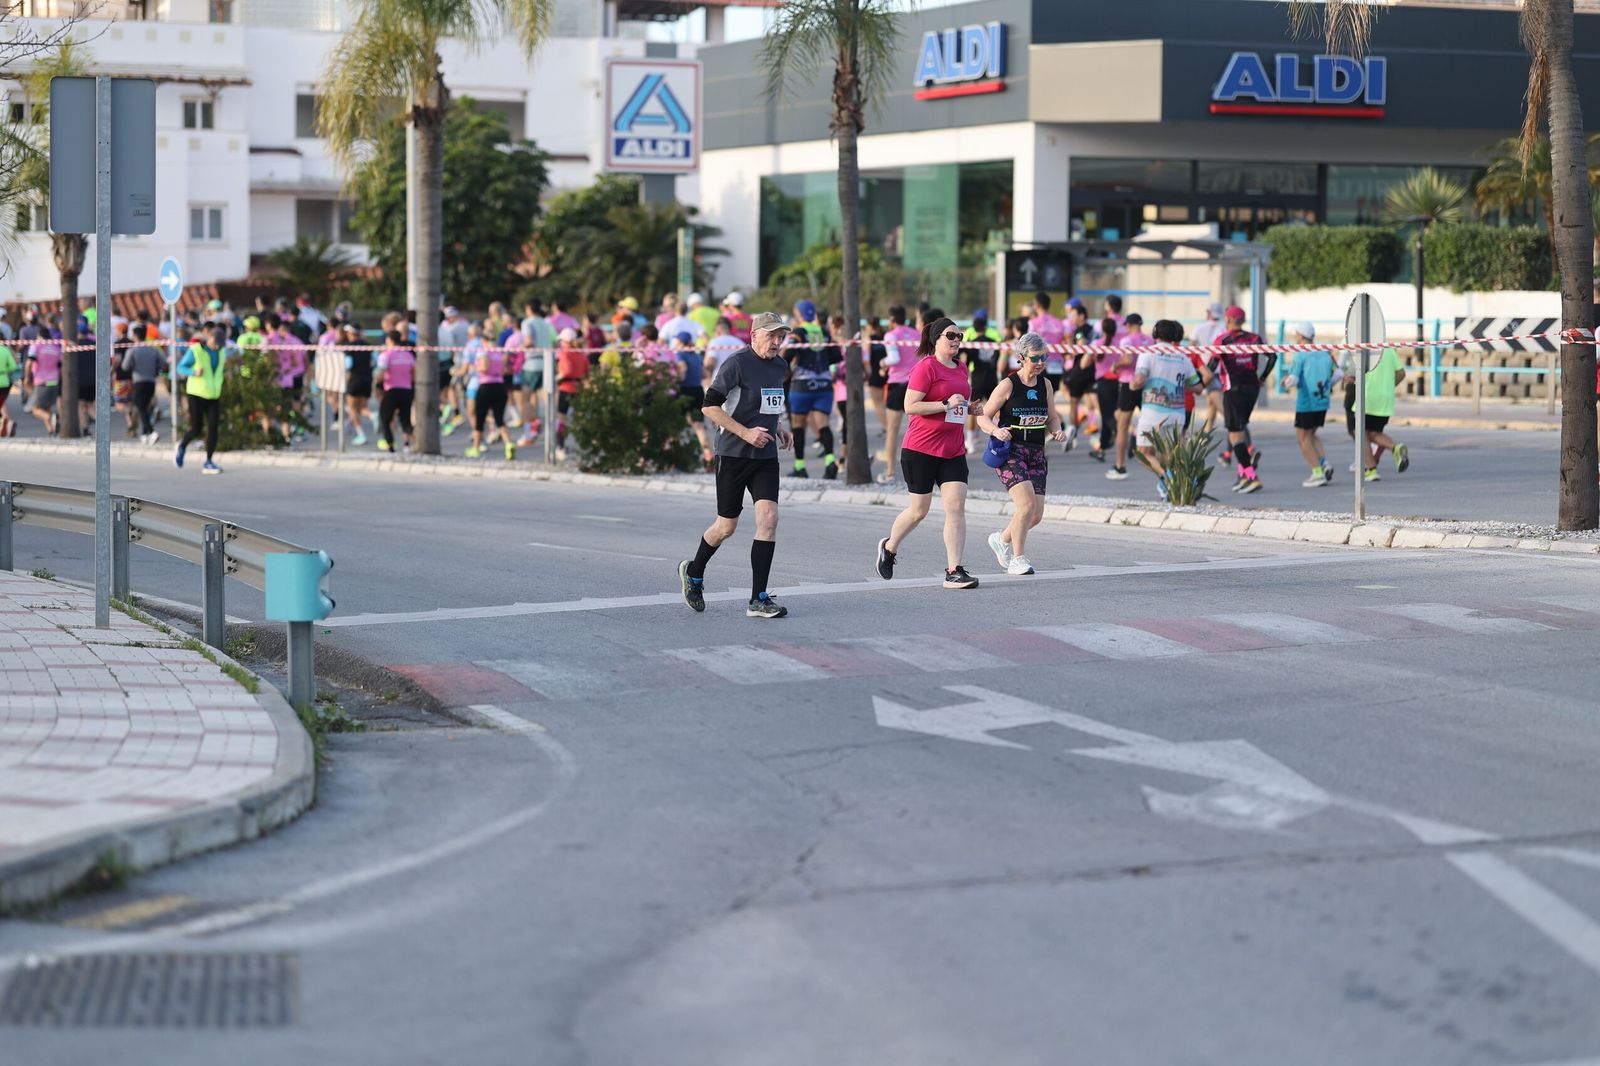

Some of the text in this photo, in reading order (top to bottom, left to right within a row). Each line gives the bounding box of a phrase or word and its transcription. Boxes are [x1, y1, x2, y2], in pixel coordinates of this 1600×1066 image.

[912, 20, 1004, 87] ALDI
[1212, 51, 1387, 105] ALDI
[619, 139, 685, 158] ALDI
[766, 396, 782, 407] 167
[953, 406, 964, 416] 33
